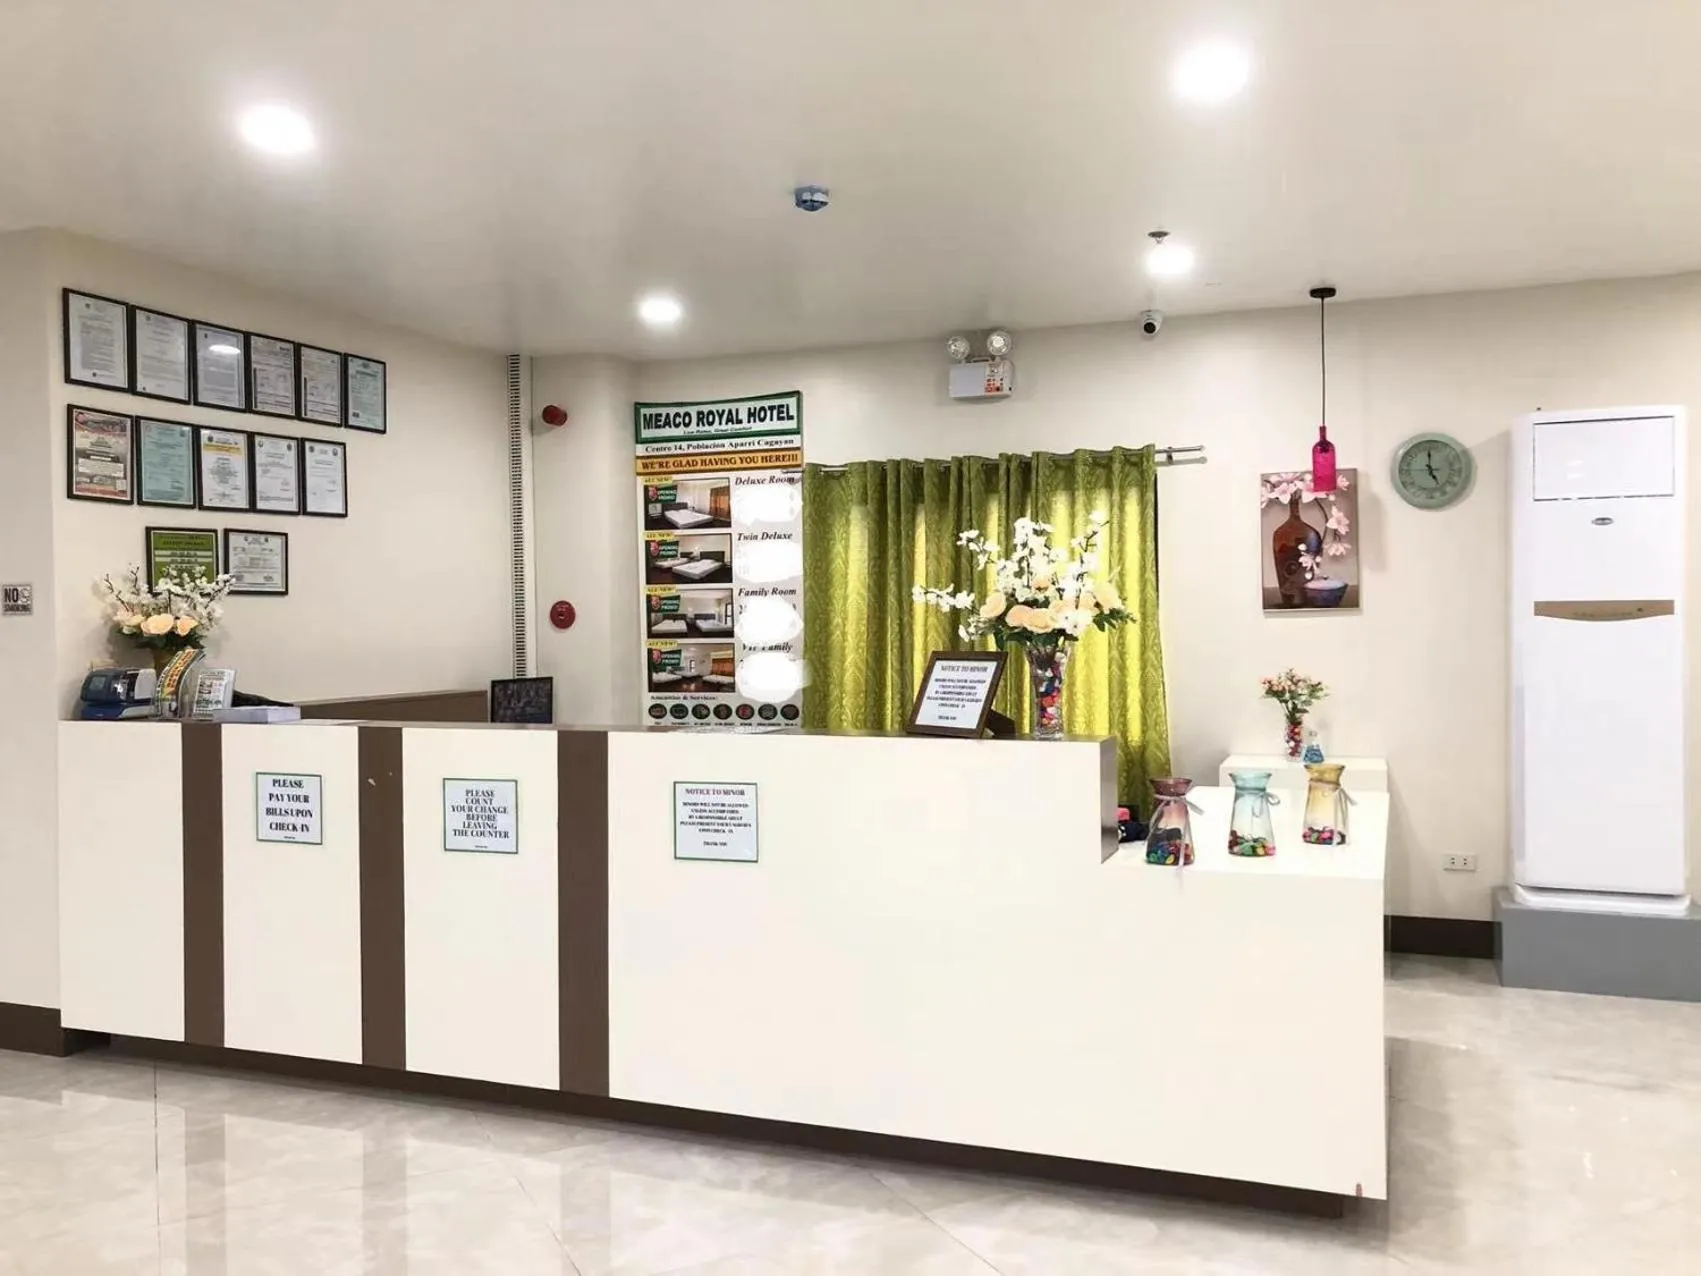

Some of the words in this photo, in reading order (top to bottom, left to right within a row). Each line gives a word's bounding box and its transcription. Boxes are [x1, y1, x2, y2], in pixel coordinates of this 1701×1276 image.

[643, 410, 692, 430] MEACO
[696, 407, 743, 428] ROYAL
[747, 403, 795, 424] HOTEL
[645, 445, 673, 453] Centro
[687, 441, 726, 450] Poblacion
[728, 440, 755, 449] Aparri
[757, 438, 794, 447] Cagayan
[641, 460, 670, 470] WE'RE
[672, 459, 698, 469] GLAD
[700, 457, 737, 467] HAVING
[739, 455, 759, 465] YOU
[760, 453, 798, 464] HERE!!!
[735, 476, 767, 486] Deluxe
[769, 474, 796, 484] Room
[737, 533, 759, 542] Twin
[760, 532, 793, 541] Deluxe
[4, 588, 19, 603] NO
[738, 587, 769, 598] Family
[771, 587, 797, 596] Room
[272, 778, 305, 789] PLEASE
[268, 792, 285, 802] PAY
[286, 793, 310, 804] YOUR
[465, 788, 495, 798] PLEASE
[685, 788, 711, 796] NOTICE
[712, 788, 722, 796] TO
[722, 789, 745, 797] MINOR
[465, 797, 494, 806] COUNT
[265, 807, 290, 817] BILLS
[290, 808, 313, 818] UPON
[451, 804, 474, 813] YOUR
[474, 805, 508, 814] CHANGE
[466, 813, 497, 822] BEFORE
[463, 821, 498, 830] LEAVING
[452, 829, 469, 837] THE
[470, 830, 510, 839] COUNTER
